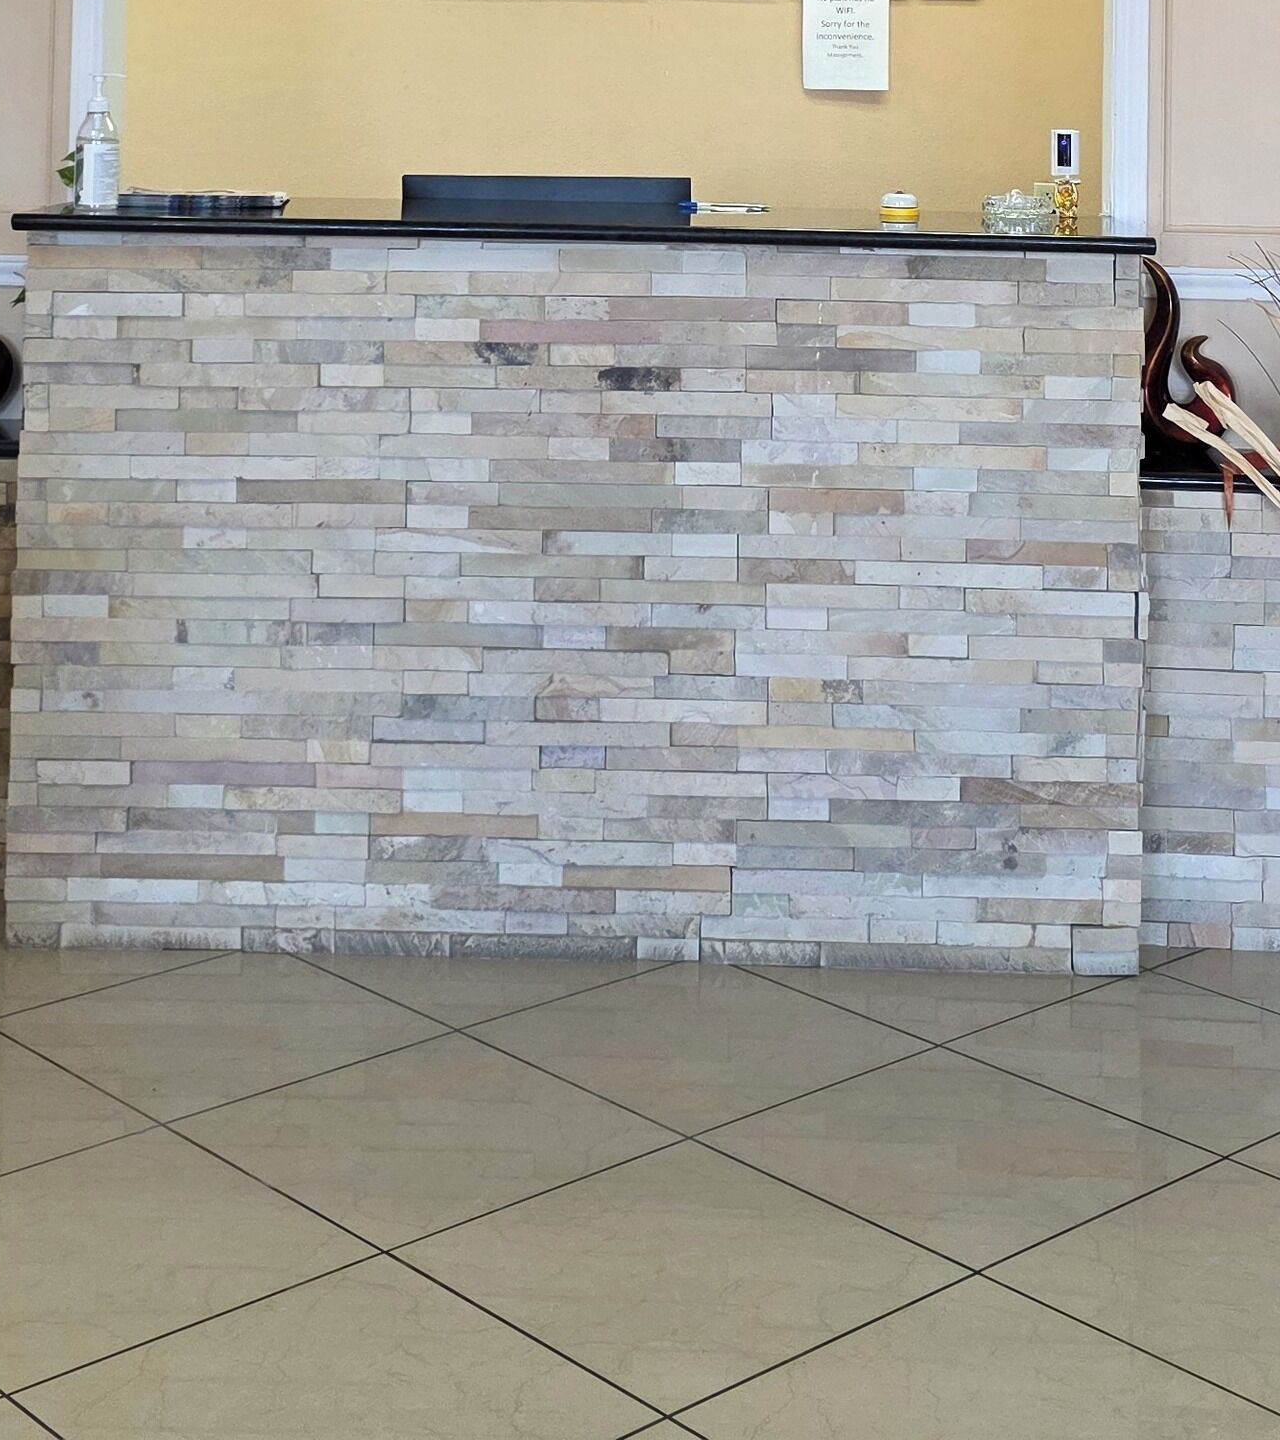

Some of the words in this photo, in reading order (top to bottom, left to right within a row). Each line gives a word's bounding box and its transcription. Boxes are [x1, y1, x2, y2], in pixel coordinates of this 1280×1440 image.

[821, 20, 842, 31] Sorry
[843, 20, 855, 28] for
[856, 20, 870, 28] the
